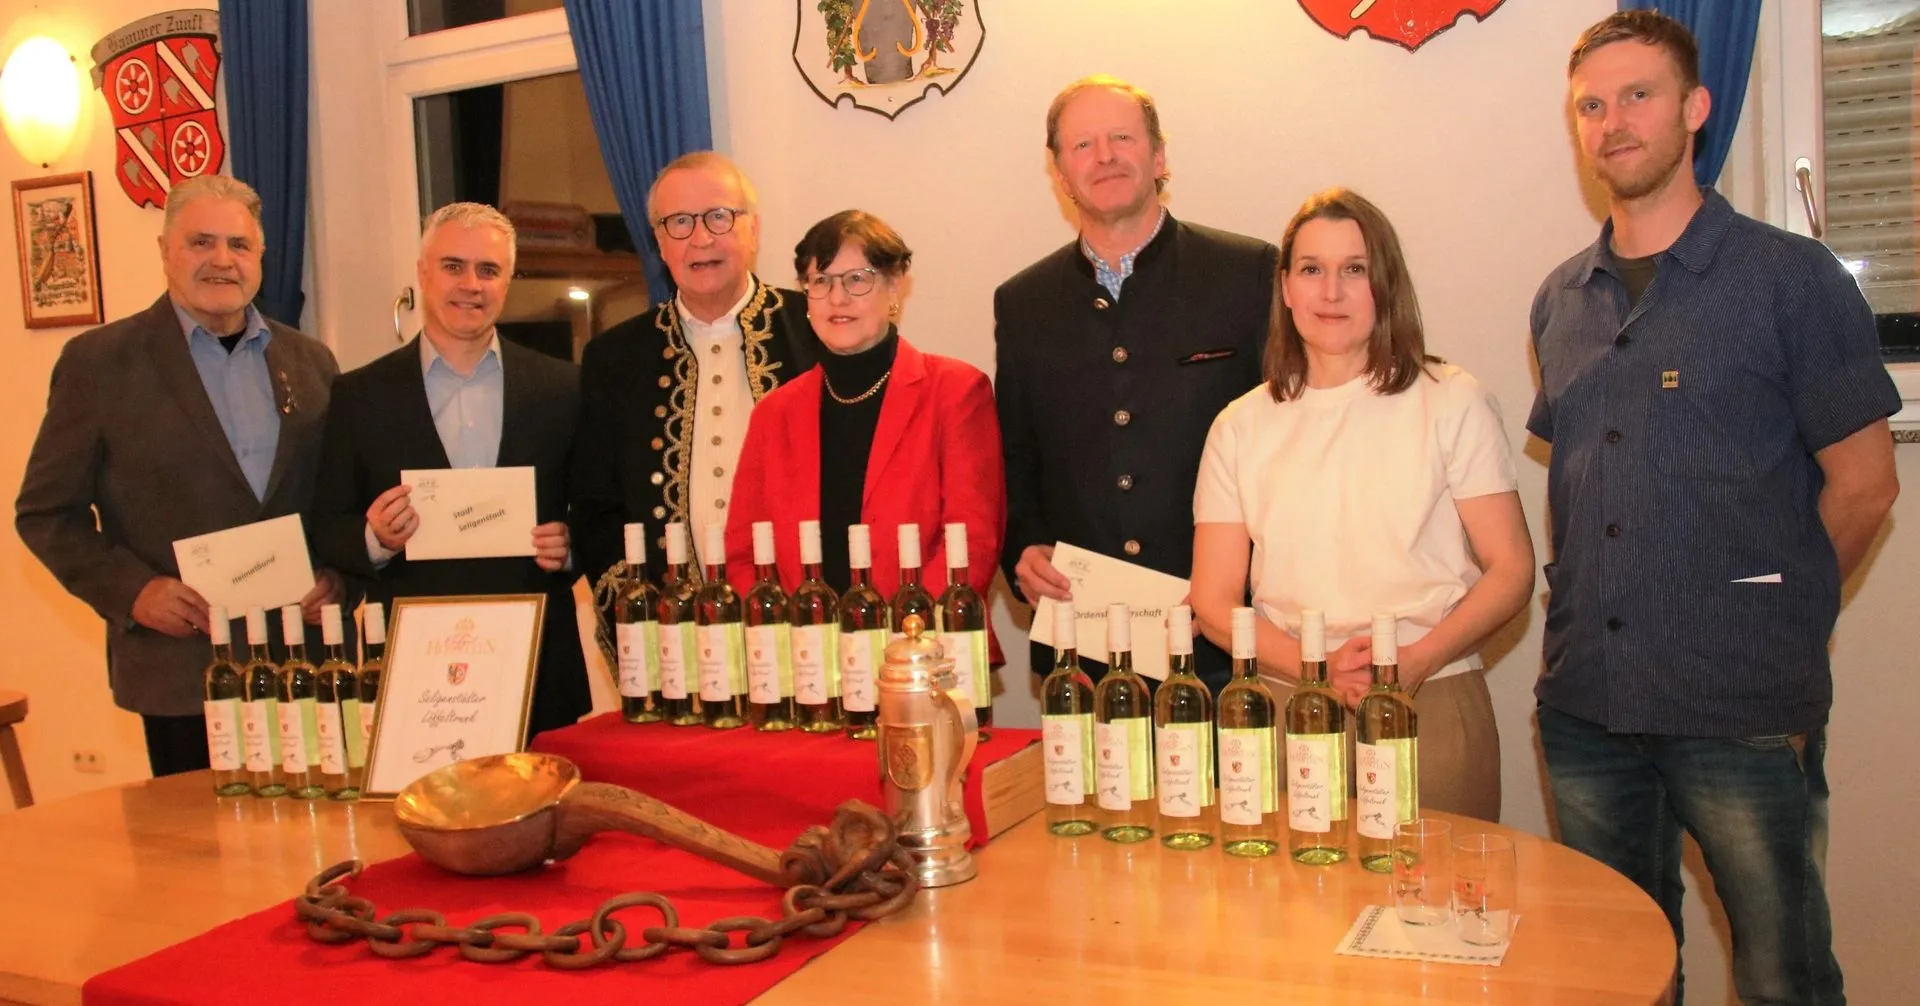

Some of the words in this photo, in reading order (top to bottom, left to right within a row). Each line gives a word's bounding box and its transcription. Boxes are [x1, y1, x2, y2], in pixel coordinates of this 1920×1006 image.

[165, 14, 203, 32] Zunft
[453, 506, 473, 519] Stadt
[458, 508, 506, 532] Seligenstadt
[231, 554, 276, 585] Heimatbund
